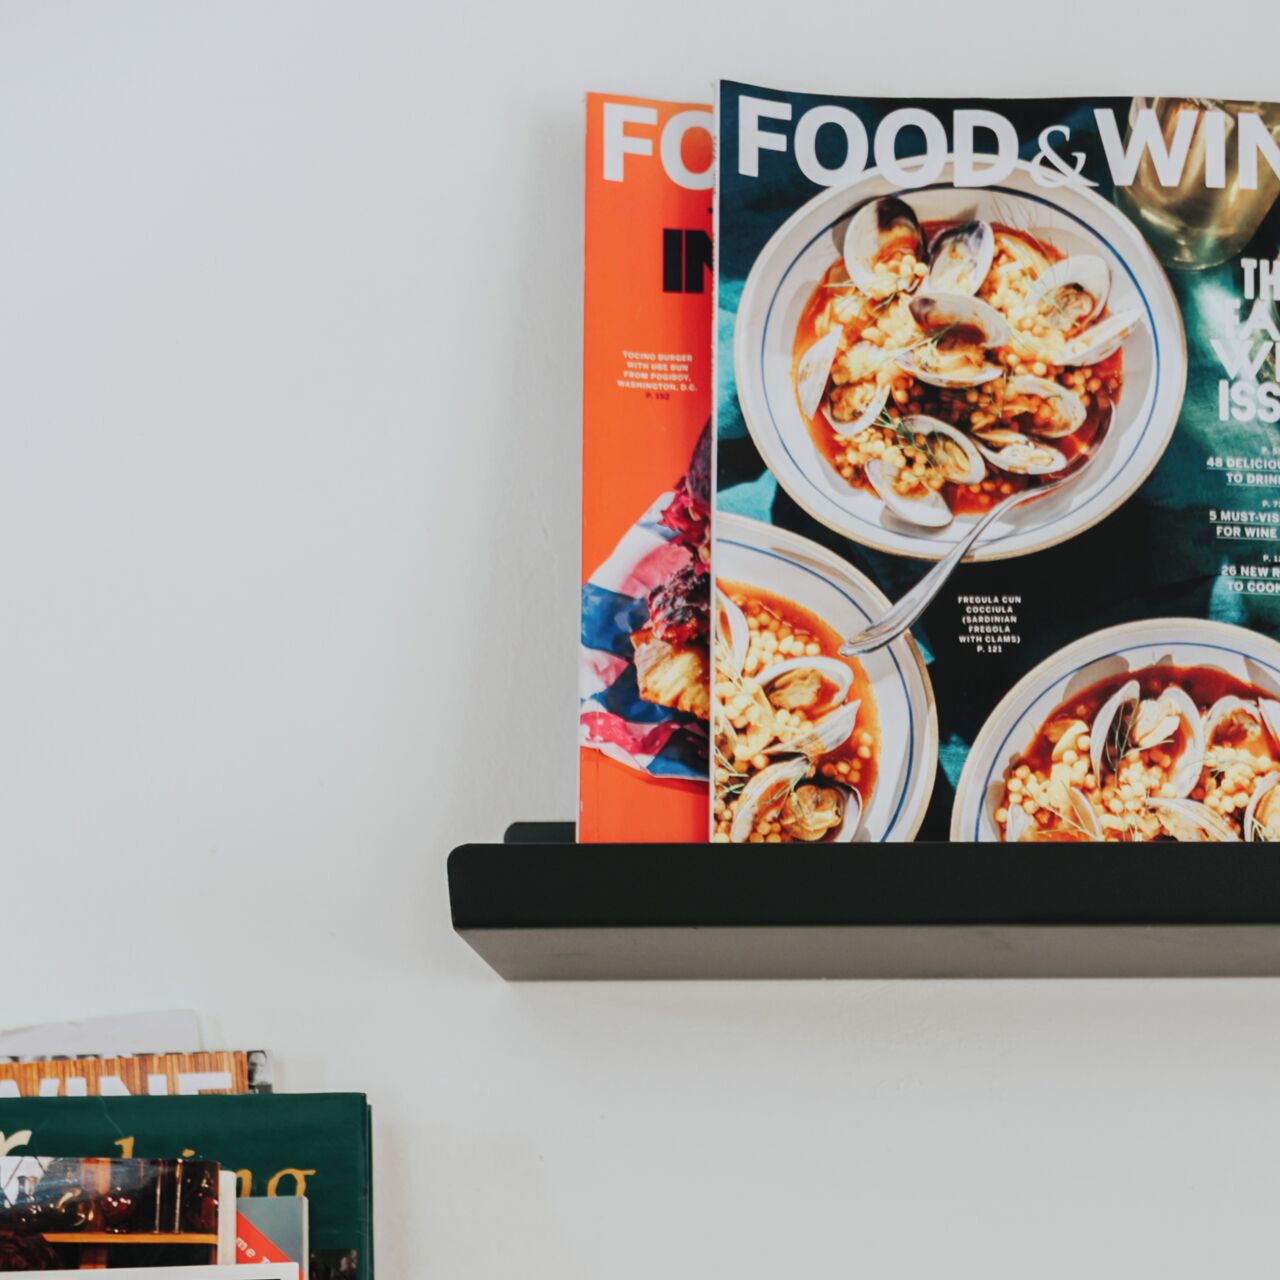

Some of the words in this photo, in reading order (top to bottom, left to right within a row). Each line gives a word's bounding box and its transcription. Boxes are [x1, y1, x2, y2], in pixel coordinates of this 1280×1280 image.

[738, 94, 1019, 189] FOOD
[1029, 123, 1099, 189] &
[623, 350, 656, 361] TOCINO
[657, 353, 693, 362] BURGER
[626, 361, 649, 370] WITH
[670, 363, 689, 372] BUN
[623, 371, 648, 380] FROM
[1206, 456, 1223, 468] 48
[1226, 472, 1243, 484] TO
[1261, 500, 1271, 508] P.
[1209, 510, 1217, 521] 5
[1216, 526, 1241, 537] FOR
[1244, 527, 1278, 539] WINE
[1263, 554, 1271, 562] P.
[1221, 566, 1237, 576] 26
[1240, 566, 1269, 577] NEW
[1227, 580, 1244, 592] TO
[957, 595, 999, 604] FREGULA
[1001, 596, 1022, 604] CUN
[965, 605, 1014, 614] COCCIULA
[961, 615, 1017, 625] (SARDINIAN
[968, 625, 1011, 633] FREGOLA
[958, 635, 983, 643] WITH
[985, 635, 1021, 644] CLAMS)
[976, 645, 985, 653] P.
